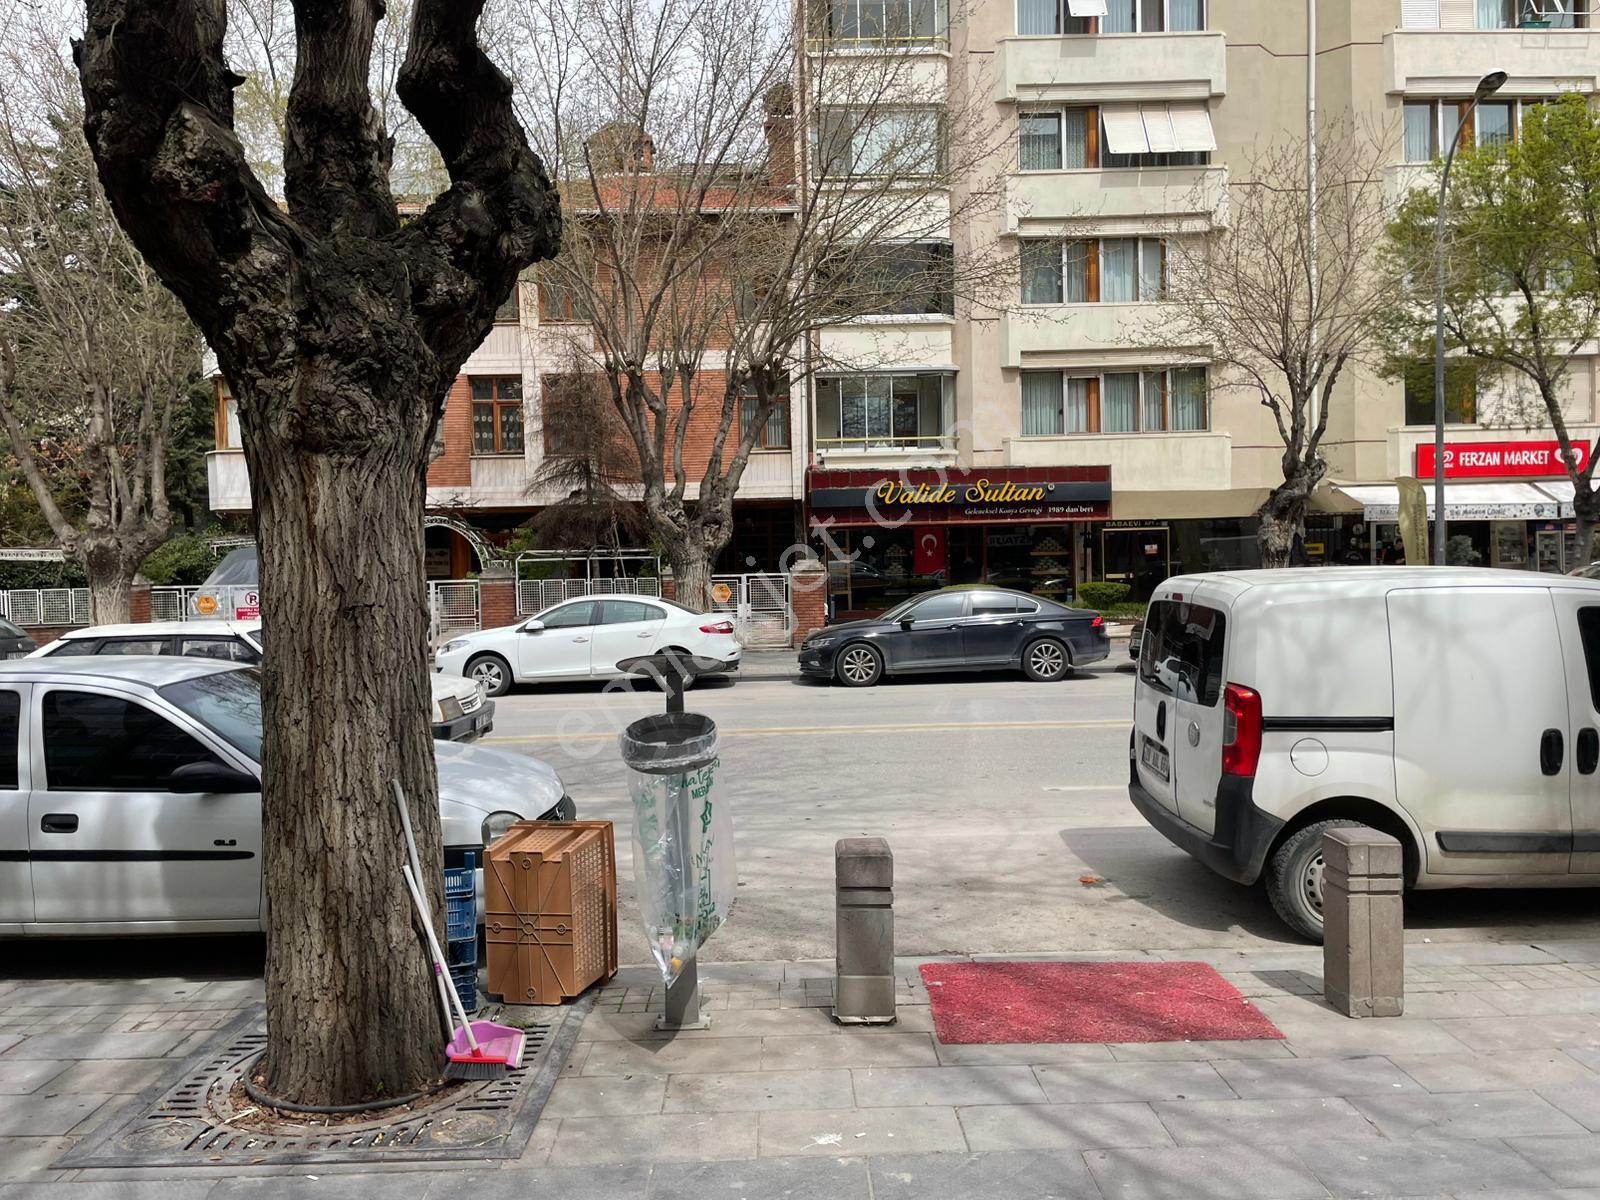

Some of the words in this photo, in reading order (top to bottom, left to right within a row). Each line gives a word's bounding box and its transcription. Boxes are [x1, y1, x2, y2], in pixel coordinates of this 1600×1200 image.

[1459, 451, 1500, 466] FERZAN
[1504, 450, 1550, 465] MARKET
[877, 480, 957, 504] Valide
[965, 479, 1046, 503] Sultan
[999, 507, 1018, 515] Konya
